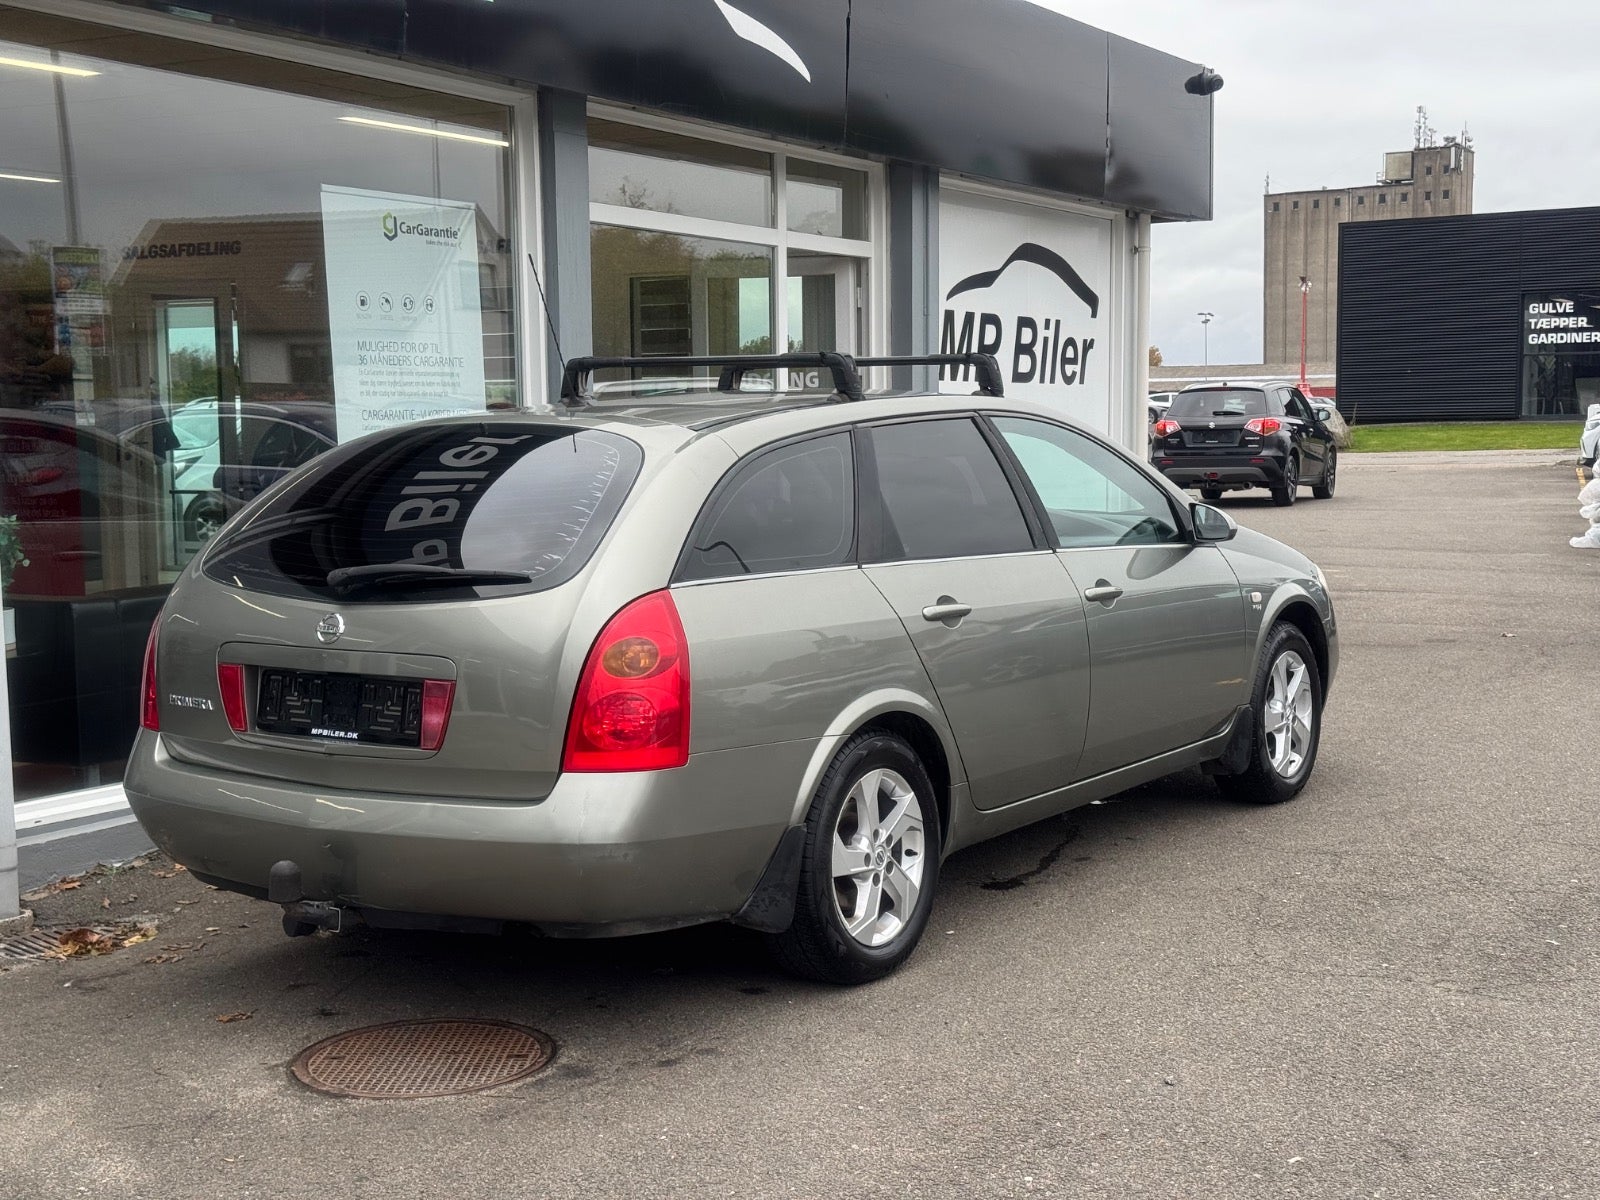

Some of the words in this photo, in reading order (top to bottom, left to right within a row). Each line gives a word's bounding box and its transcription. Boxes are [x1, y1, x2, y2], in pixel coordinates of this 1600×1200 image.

[399, 221, 459, 239] CarGarantie
[122, 240, 241, 260] SALGSAFDELING
[1528, 302, 1575, 314] GULVE
[1528, 317, 1588, 330] TÆPPER
[1528, 332, 1600, 345] GARDINER
[357, 340, 400, 353] MULIGHED
[400, 342, 417, 353] FOR
[417, 343, 429, 354] OP
[429, 343, 441, 354] TIL
[1011, 315, 1095, 386] Biler
[358, 354, 368, 366] 36
[369, 353, 412, 367] MÅNEDERS
[413, 356, 465, 368] CARGARANTIE
[169, 693, 214, 711] PRIMERA
[310, 728, 359, 740] MPBILER.DK
